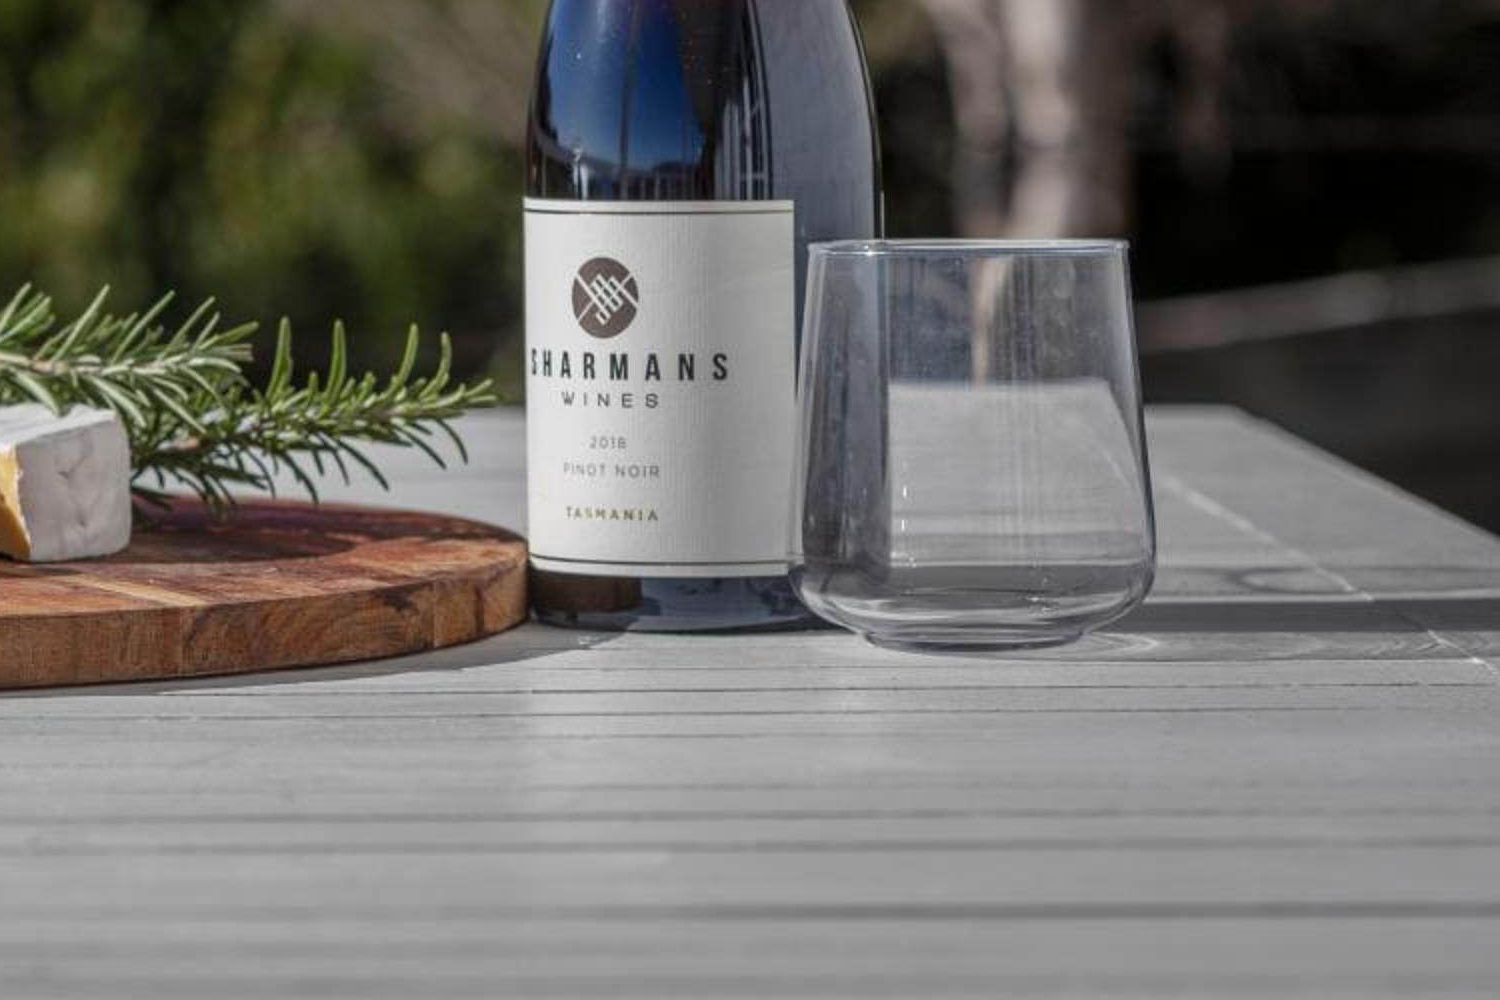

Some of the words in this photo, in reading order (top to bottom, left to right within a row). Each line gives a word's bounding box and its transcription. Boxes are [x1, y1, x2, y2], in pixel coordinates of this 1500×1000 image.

[531, 348, 729, 381] SHARMANS
[561, 391, 660, 409] WINES
[589, 436, 627, 449] 2018
[563, 462, 606, 476] PINOT
[615, 465, 660, 478] NOIR
[565, 506, 659, 521] TASMANIA
